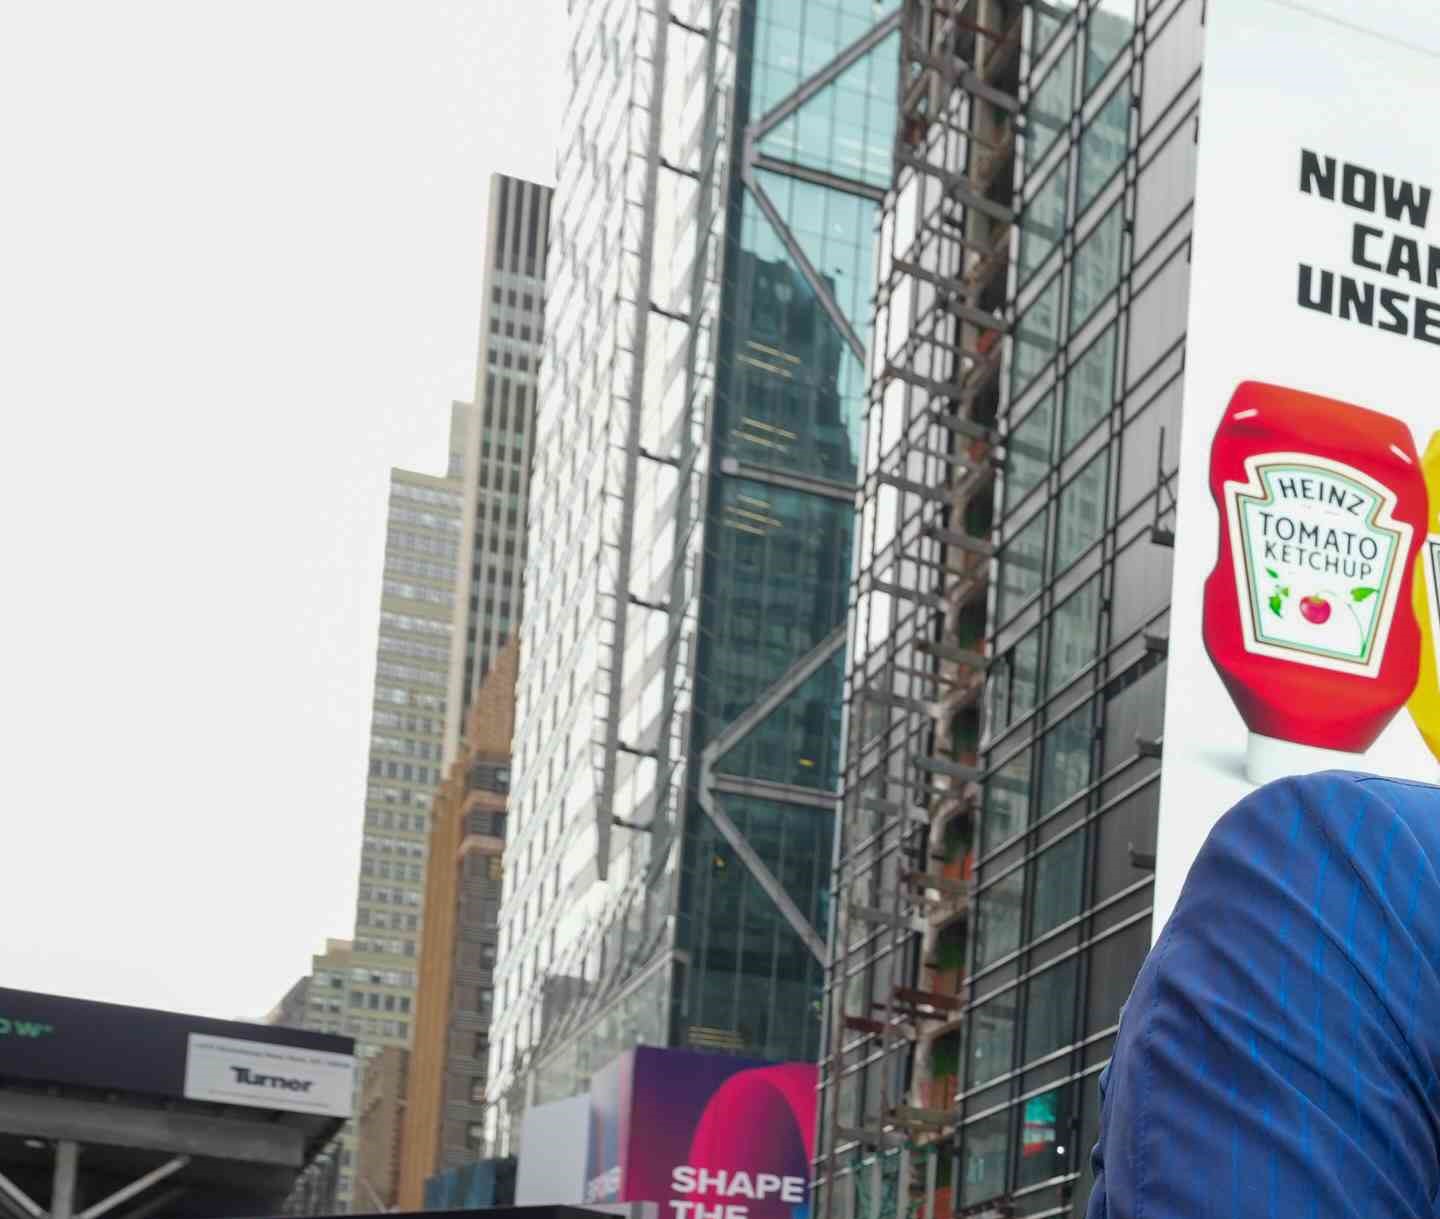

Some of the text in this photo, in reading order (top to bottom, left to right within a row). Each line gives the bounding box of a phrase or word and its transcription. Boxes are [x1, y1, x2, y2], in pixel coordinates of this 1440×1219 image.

[1299, 148, 1431, 229] NOW
[1278, 478, 1365, 516] HEINZ
[1260, 512, 1378, 560] TOMATO
[1265, 541, 1372, 580] KETCHUP
[230, 1066, 313, 1093] Turner
[671, 1166, 805, 1203] SHAPE
